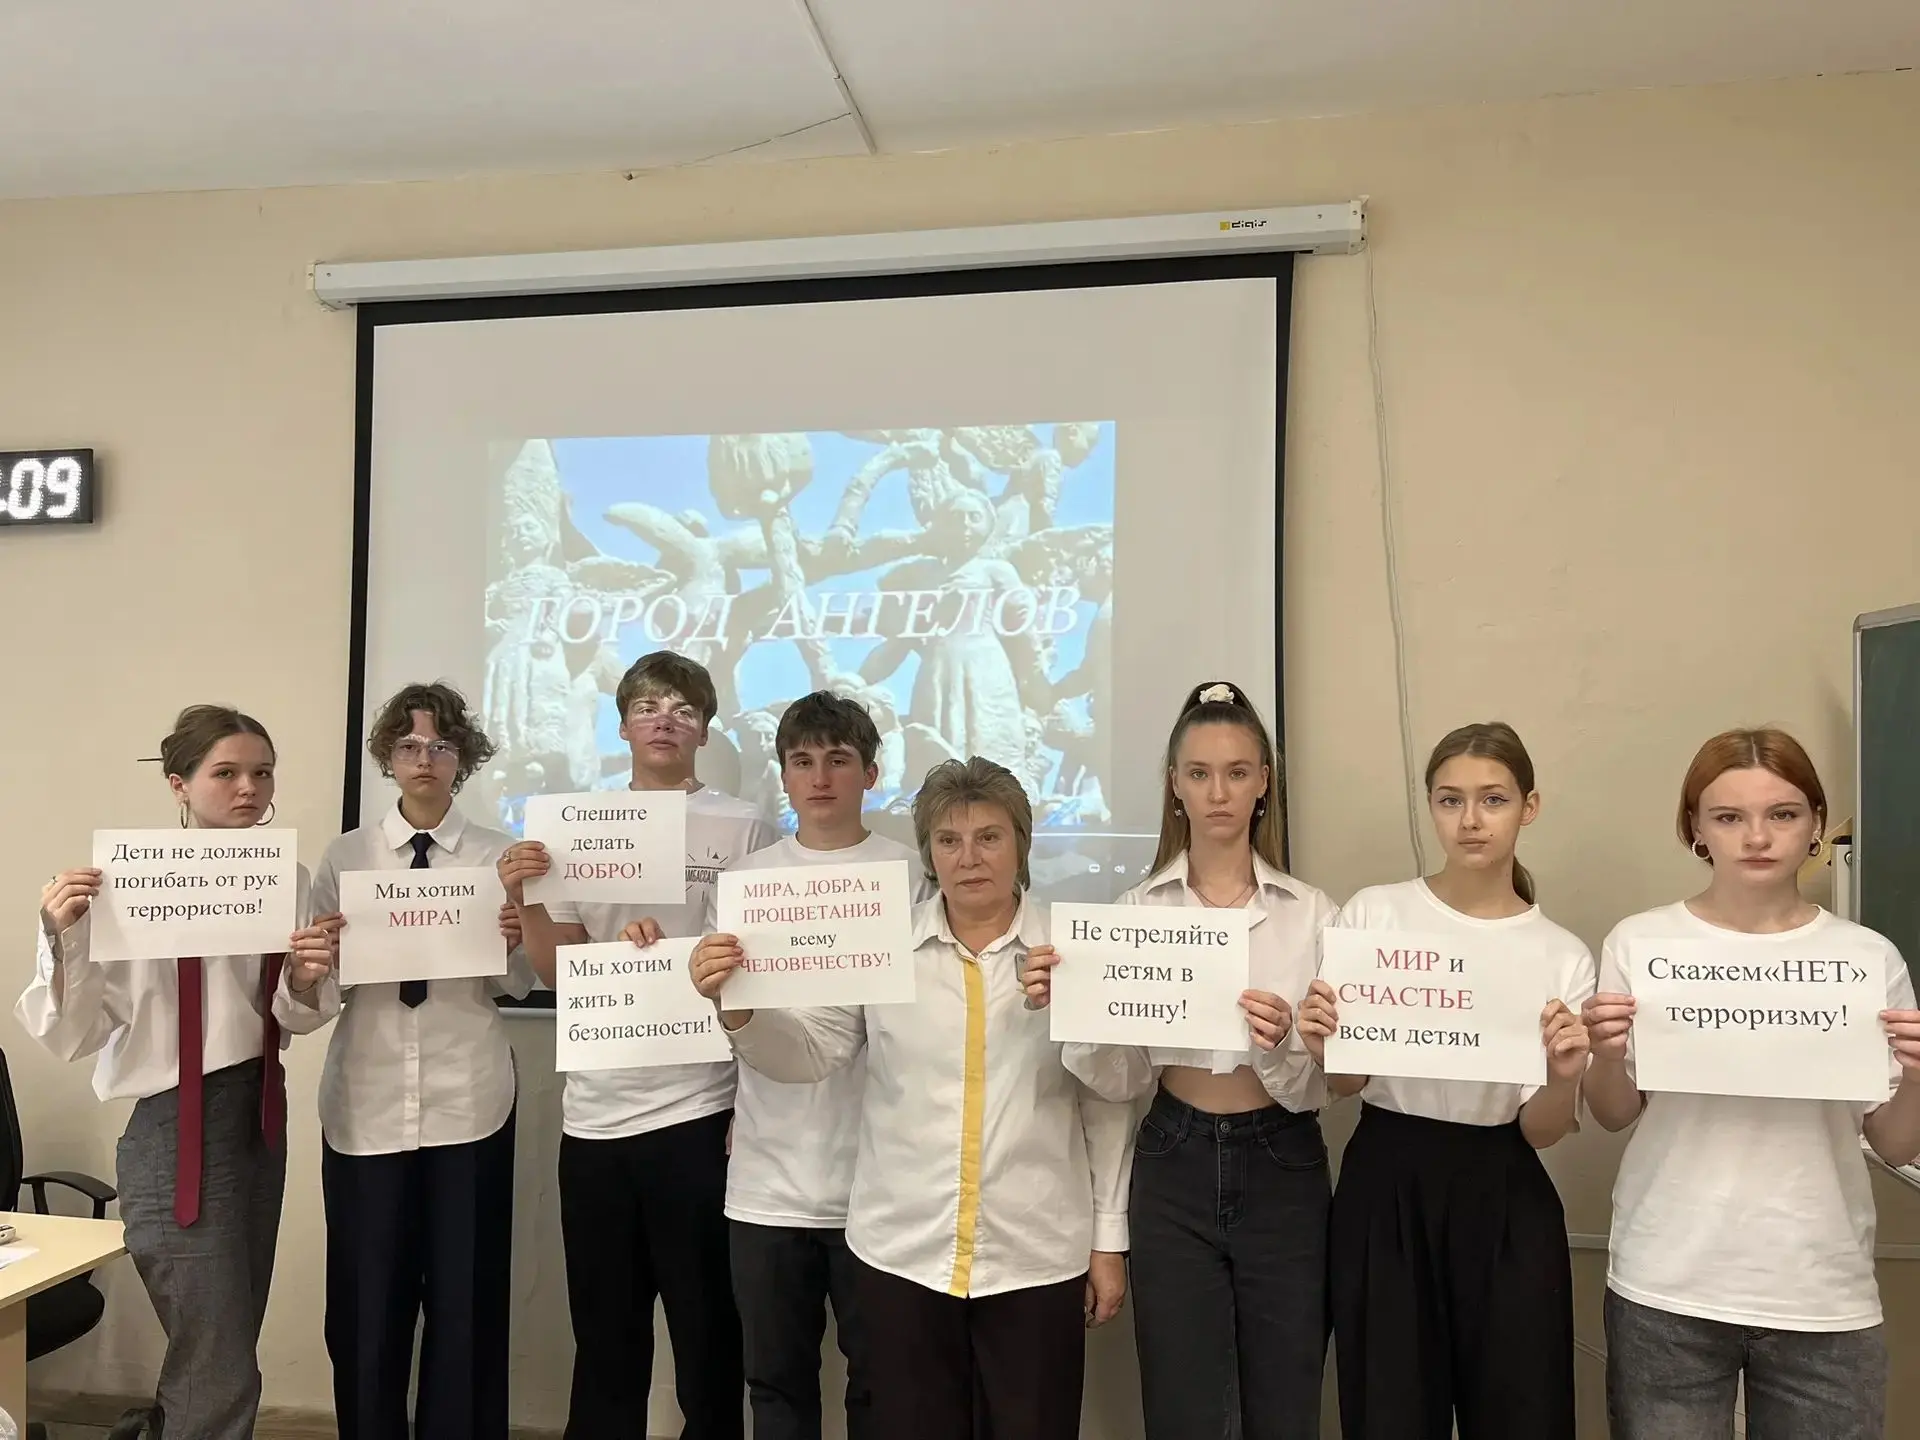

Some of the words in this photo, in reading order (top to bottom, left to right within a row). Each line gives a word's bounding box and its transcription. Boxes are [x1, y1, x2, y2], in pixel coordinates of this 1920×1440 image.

[519, 593, 738, 651] ГОРОД
[759, 585, 1081, 640] АНГЕЛОВ
[561, 805, 648, 822] Спешите
[111, 843, 164, 863] Дети
[171, 847, 195, 860] не
[200, 847, 281, 861] должны
[570, 838, 635, 852] делать
[114, 871, 209, 889] погибать
[215, 875, 239, 888] от
[243, 874, 278, 891] рук
[563, 862, 642, 881] ДОБРО!
[375, 882, 410, 900] Мы
[416, 884, 475, 898] хотим
[743, 882, 800, 899] МИРА,
[804, 877, 866, 898] ДОБРА
[871, 880, 880, 892] и
[126, 898, 263, 922] террористов!
[389, 908, 461, 928] МИРА!
[743, 902, 881, 924] ПРОЦВЕТАНИЯ
[790, 933, 837, 949] всему
[1071, 919, 1102, 941] Не
[1109, 924, 1229, 949] стреляйте
[568, 959, 604, 978] Мы
[610, 958, 672, 975] хотим
[740, 952, 892, 974] ЧЕЛОВЕЧЕСТВУ!
[1375, 948, 1441, 972] МИР
[1449, 958, 1464, 973] и
[1102, 964, 1172, 982] детям
[1181, 967, 1194, 983] в
[568, 994, 618, 1010] жить
[624, 993, 635, 1006] в
[1338, 983, 1474, 1010] СЧАСТЬЕ
[1107, 999, 1187, 1025] спину!
[1665, 1004, 1848, 1033] терроризму!
[568, 1014, 712, 1042] безопасности!
[1339, 1025, 1397, 1042] всем
[1404, 1029, 1480, 1048] детям
